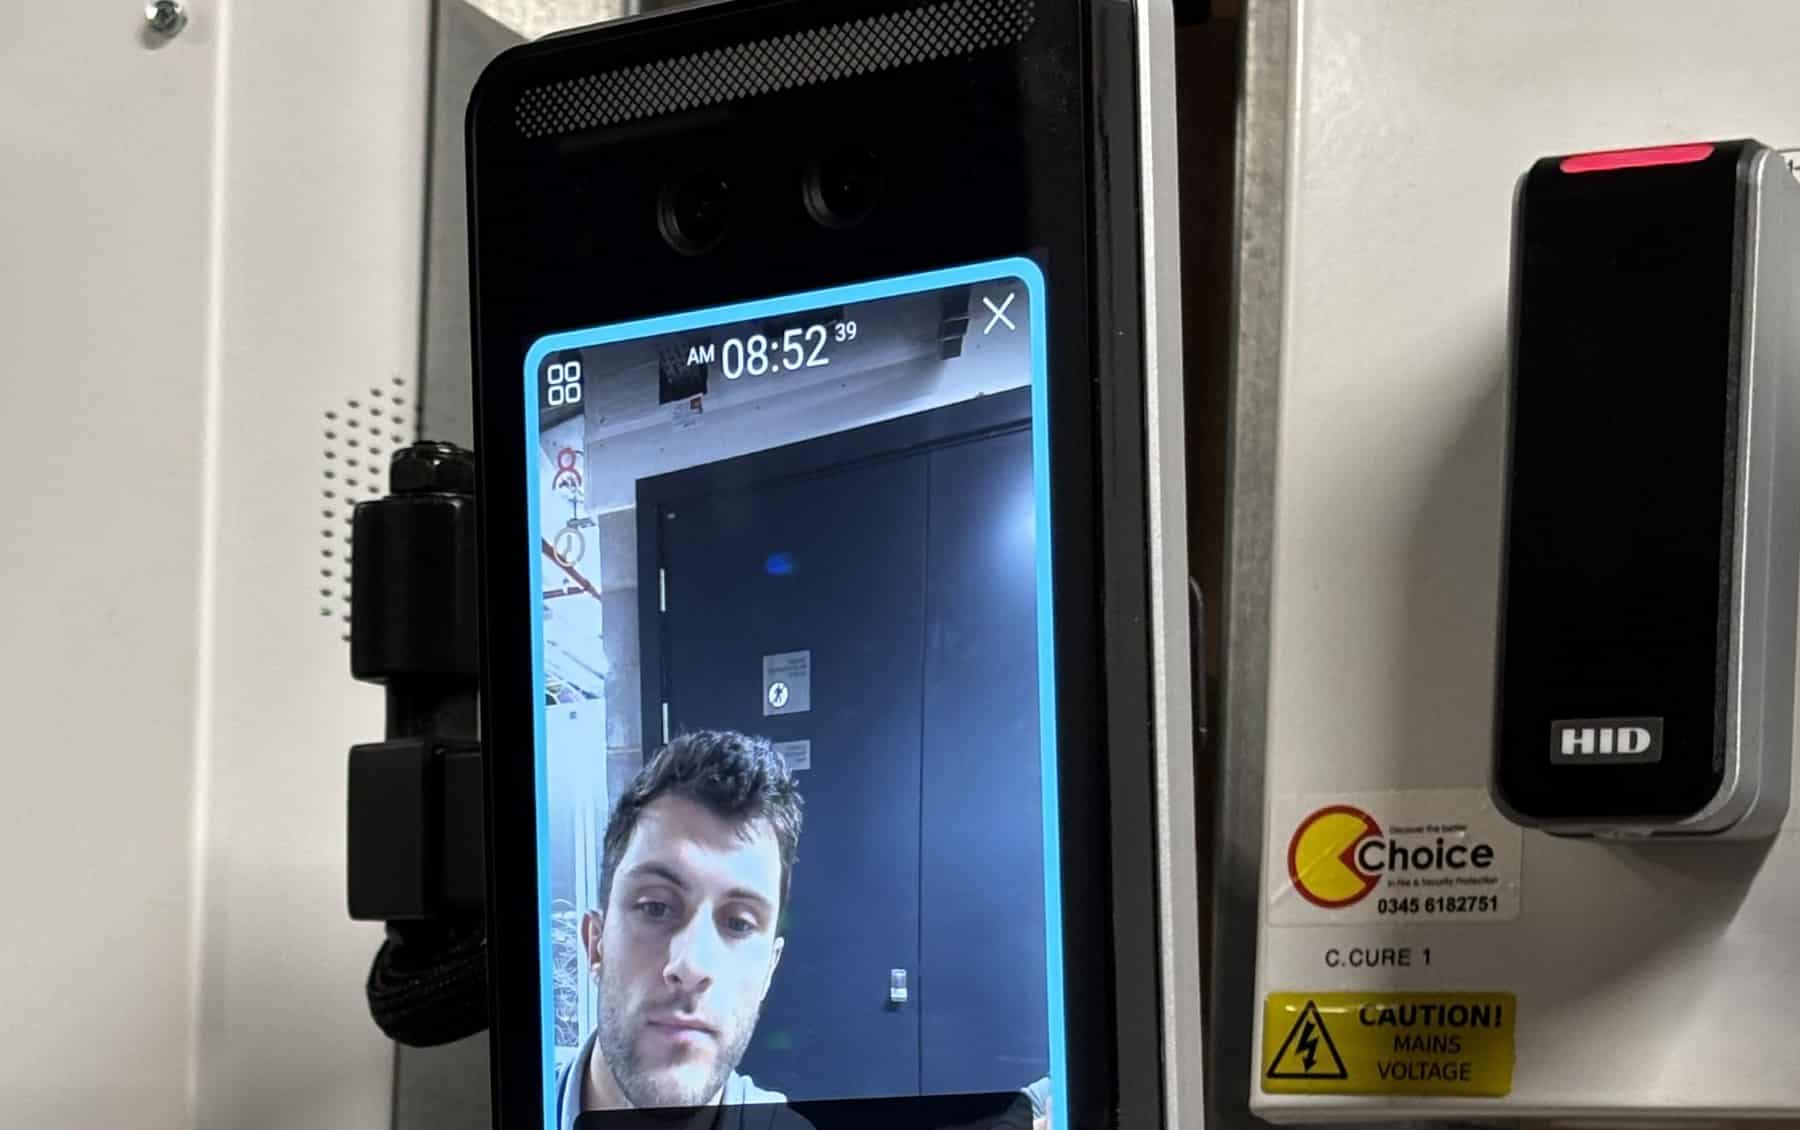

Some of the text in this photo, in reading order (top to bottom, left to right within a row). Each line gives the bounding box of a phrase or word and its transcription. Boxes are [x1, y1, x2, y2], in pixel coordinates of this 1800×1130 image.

[686, 321, 857, 380] AM 08:52 39
[1561, 727, 1651, 754] HID
[1357, 837, 1494, 871] Choice
[1378, 896, 1498, 914] 0345 6182751
[1325, 948, 1431, 967] C.CURE 1
[1359, 1003, 1503, 1028] CAUTION!
[1393, 1035, 1461, 1053] MAINS
[1377, 1062, 1471, 1081] VOLTAGE
